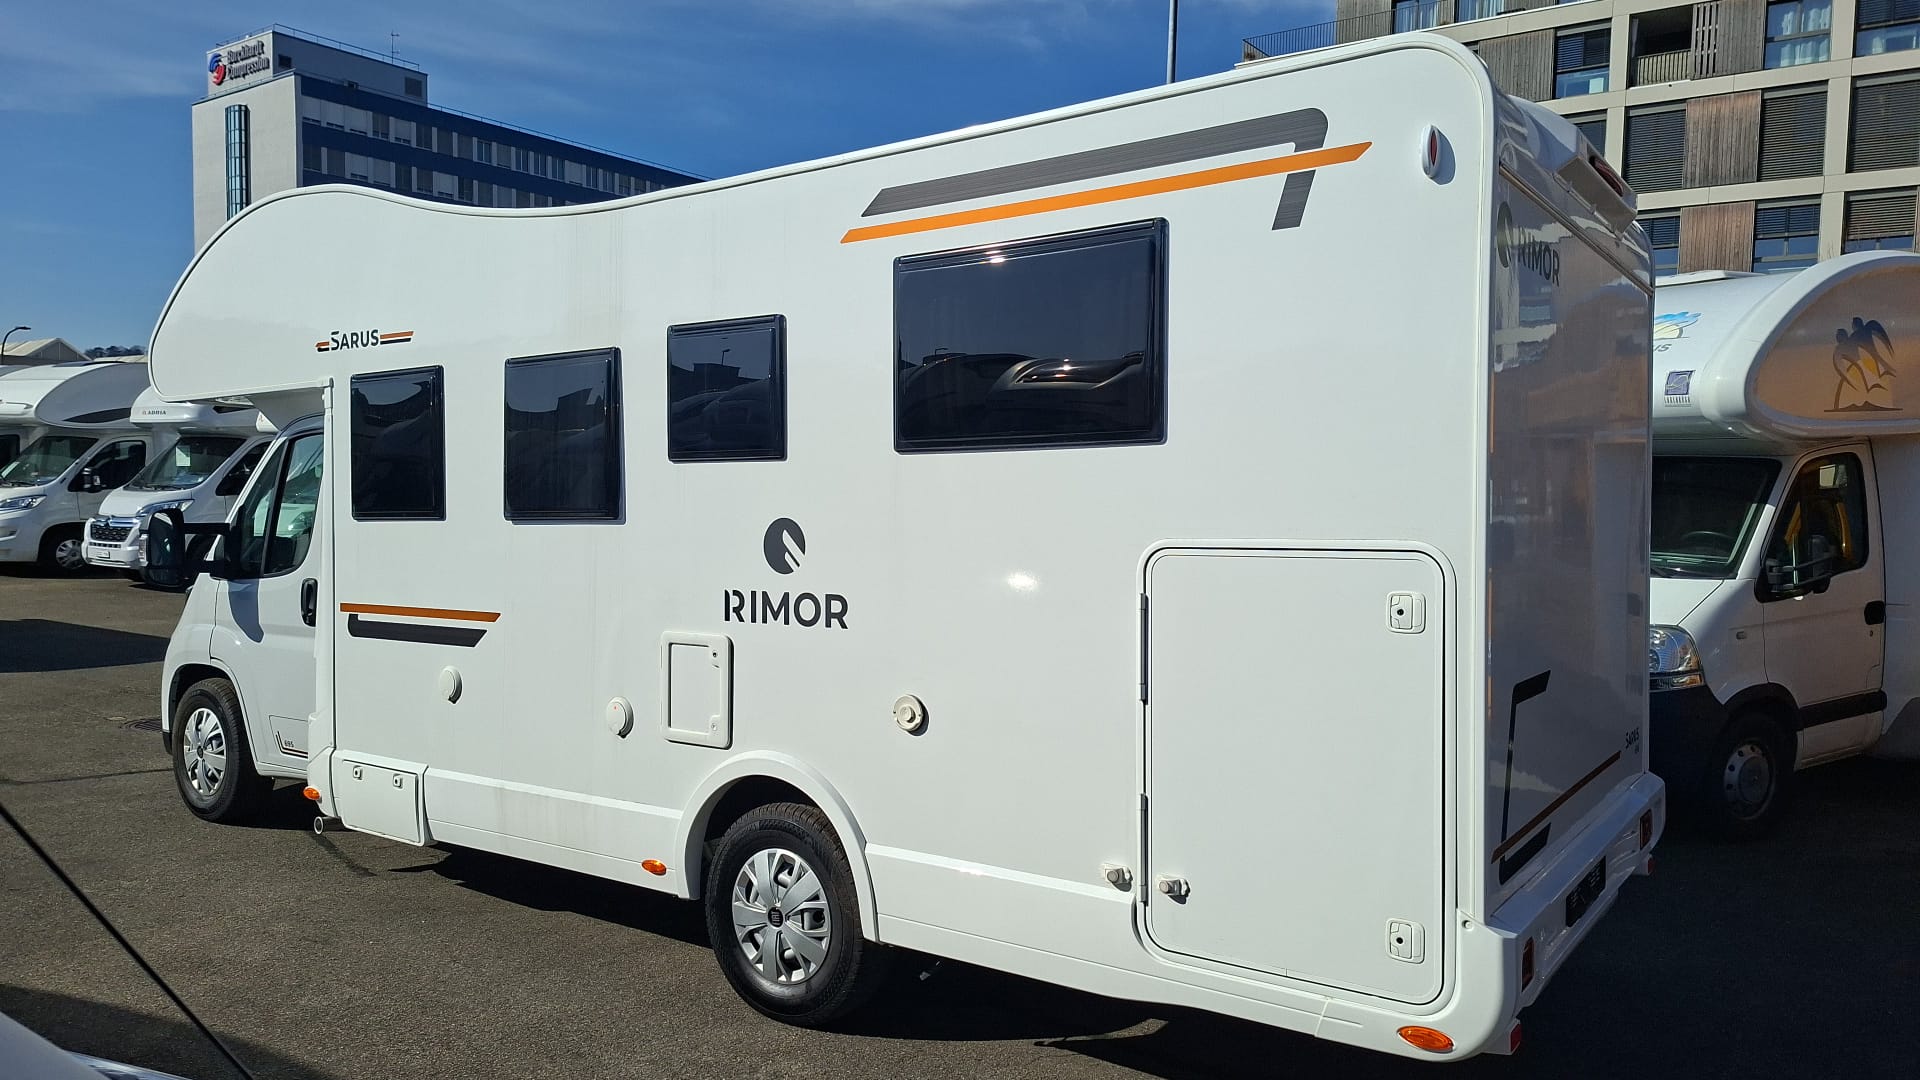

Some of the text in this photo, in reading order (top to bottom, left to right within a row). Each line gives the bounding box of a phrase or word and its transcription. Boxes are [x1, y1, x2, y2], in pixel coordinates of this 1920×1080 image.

[227, 56, 270, 80] Compression
[1517, 225, 1560, 287] RIMOR
[330, 329, 379, 351] SARUS
[724, 589, 848, 630] RIMOR
